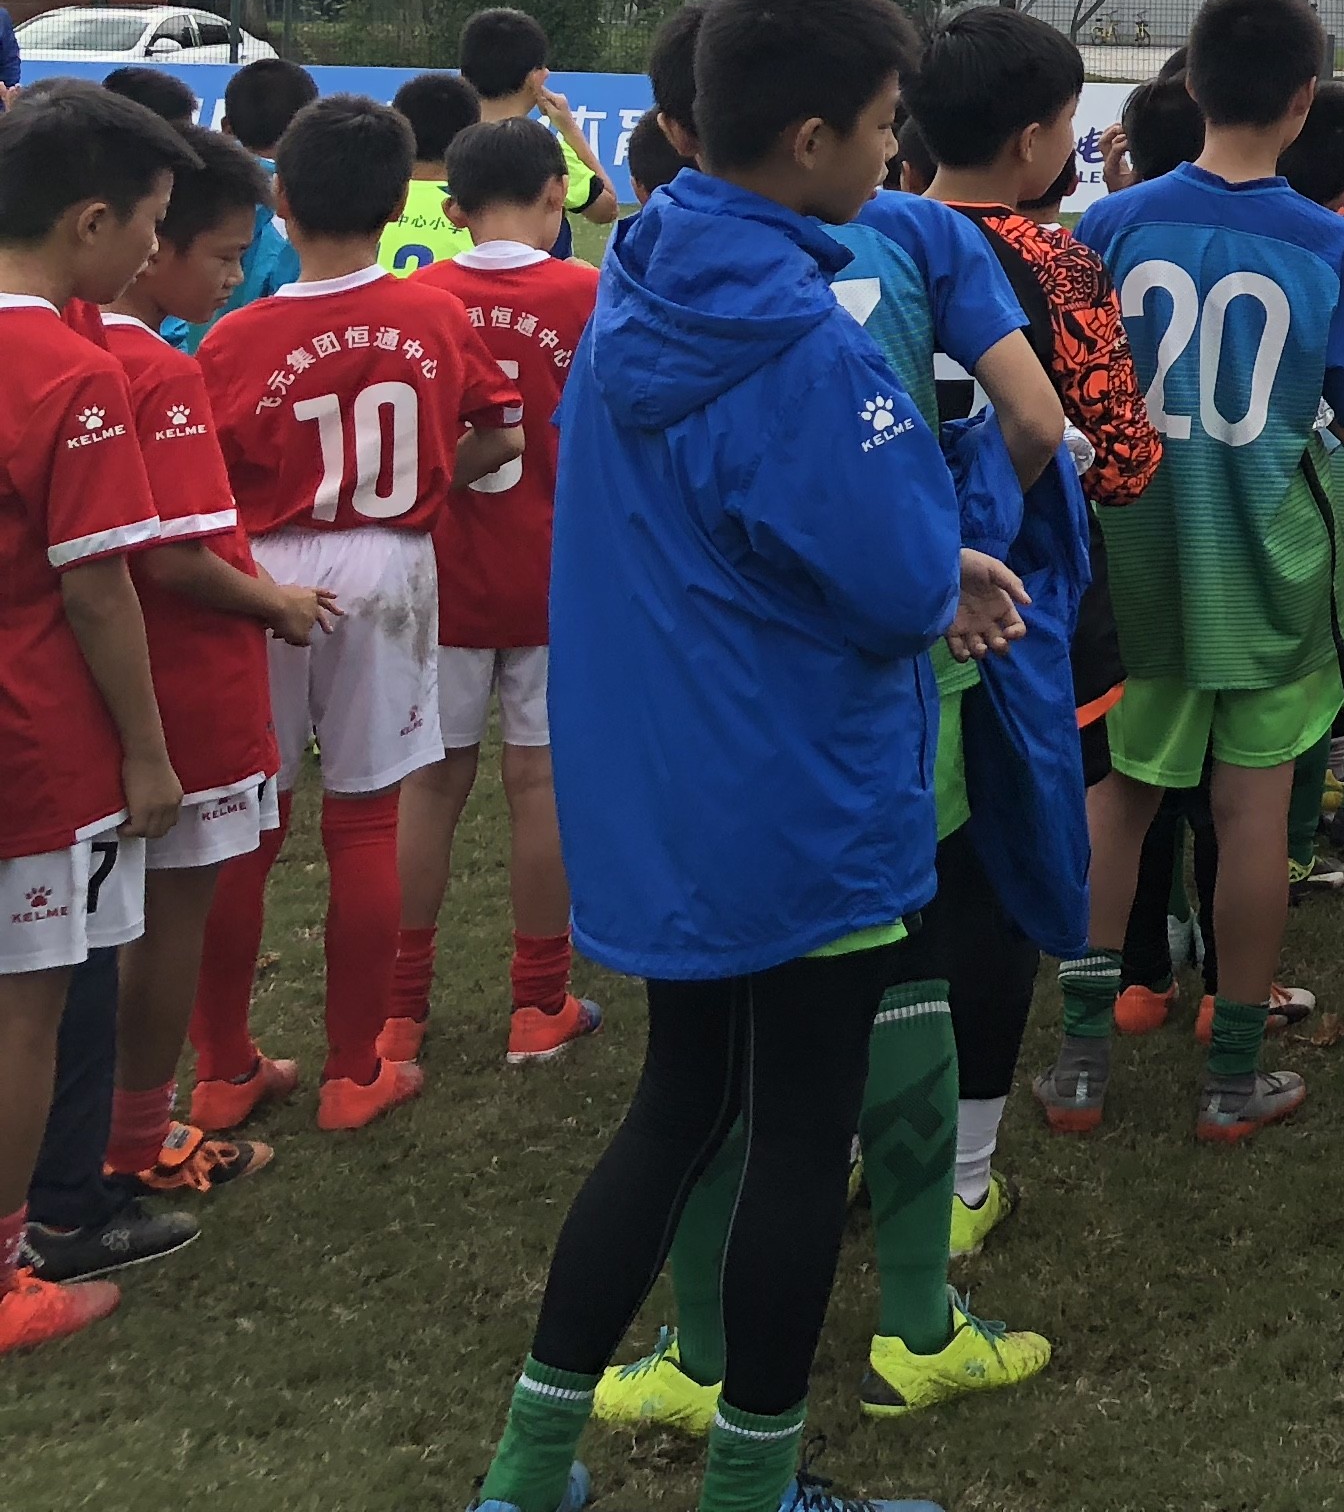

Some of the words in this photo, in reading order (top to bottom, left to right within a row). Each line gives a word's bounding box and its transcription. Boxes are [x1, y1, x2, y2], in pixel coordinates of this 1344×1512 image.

[1121, 260, 1291, 447] 20
[256, 325, 440, 416] 飞元集团恒通中心
[67, 424, 126, 449] KELME
[155, 424, 207, 441] KELME
[861, 417, 915, 453] KELME
[293, 380, 418, 523] 10
[202, 800, 247, 821] KELME
[11, 906, 68, 924] KELME
